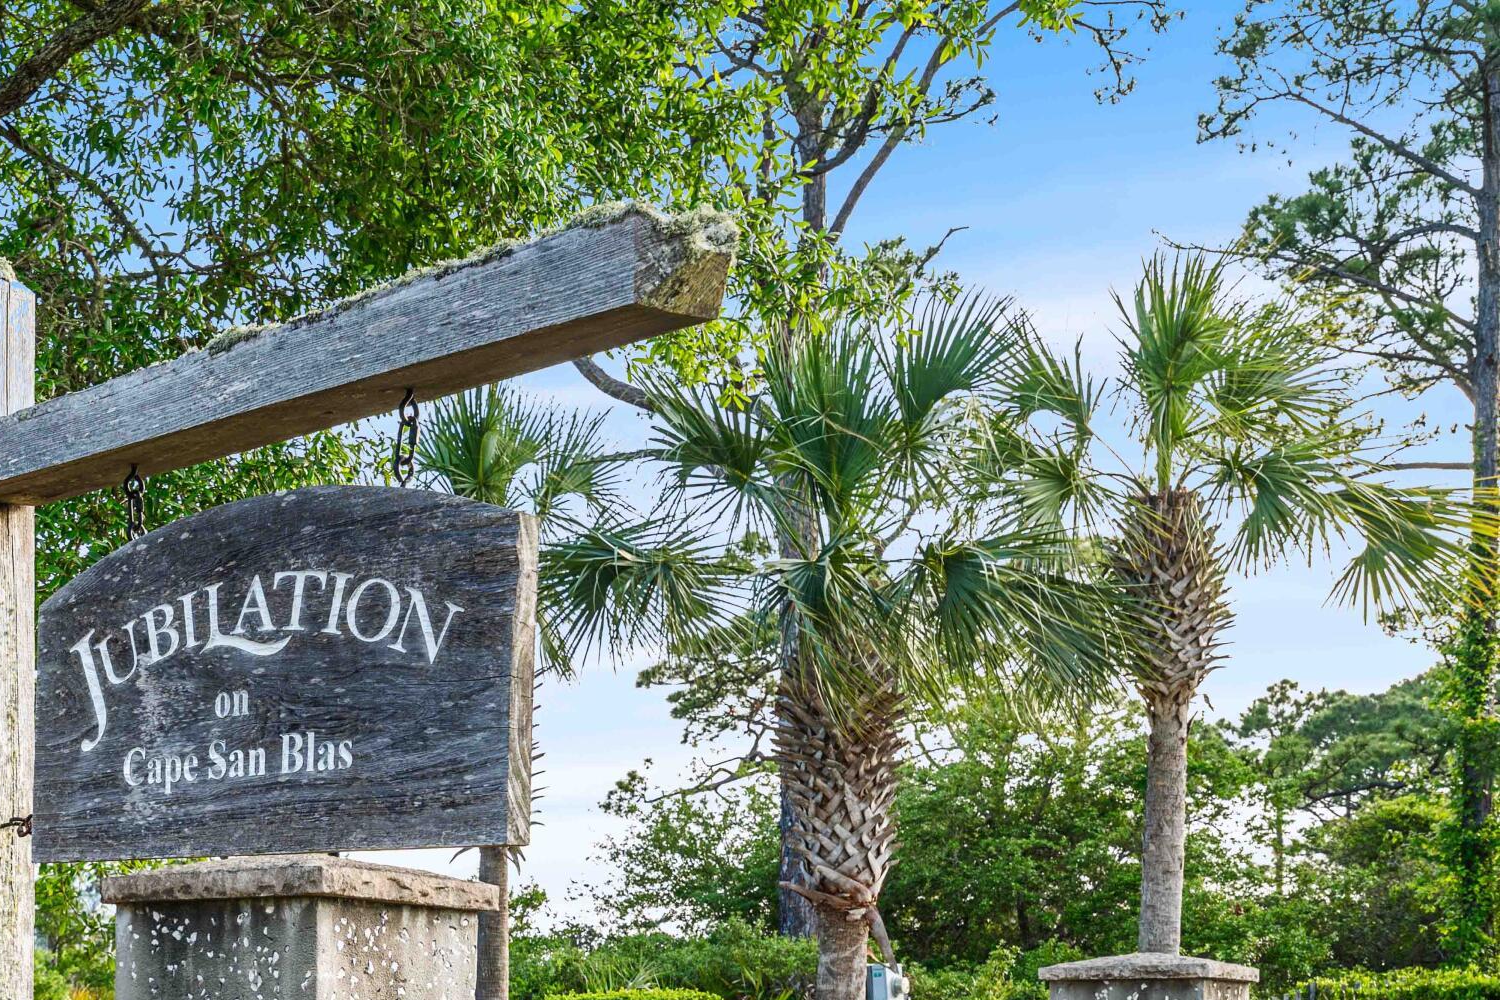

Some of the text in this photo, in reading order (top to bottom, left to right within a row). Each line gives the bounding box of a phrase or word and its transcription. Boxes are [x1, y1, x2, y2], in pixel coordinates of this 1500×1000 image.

[70, 570, 465, 752] JUBILATION
[214, 687, 250, 719] on
[122, 731, 353, 794] Cape San Blas
